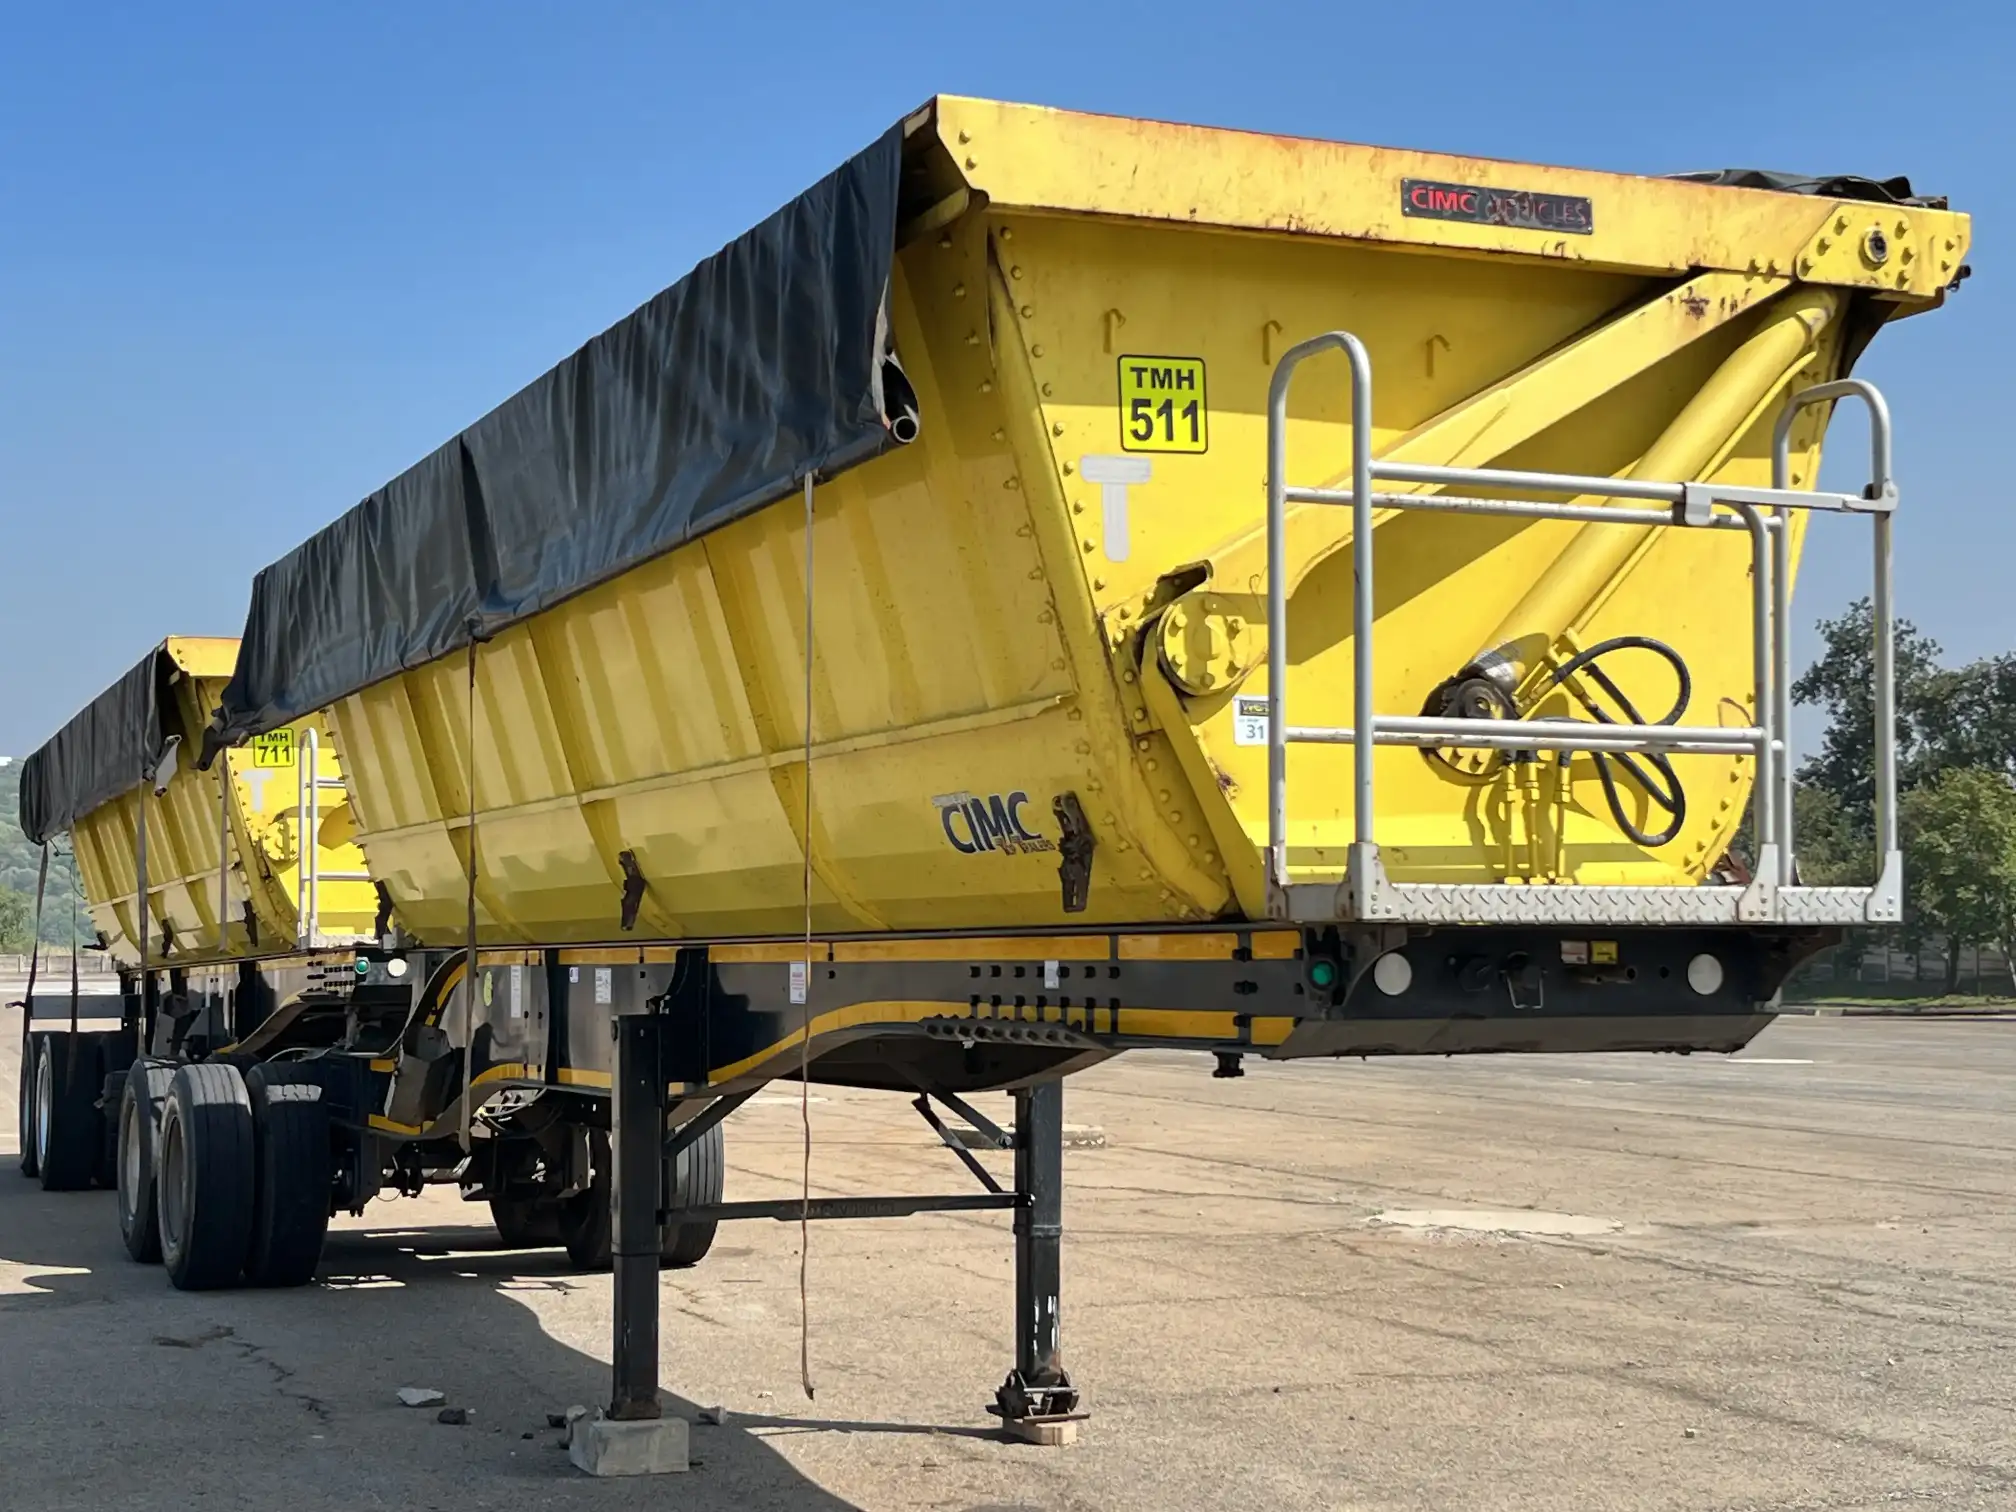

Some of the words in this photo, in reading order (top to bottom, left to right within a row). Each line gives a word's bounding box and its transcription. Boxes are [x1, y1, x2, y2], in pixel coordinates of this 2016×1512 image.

[1411, 186, 1478, 214] CIMC
[1130, 366, 1195, 390] TMH
[1130, 397, 1199, 442] 511
[1245, 724, 1264, 740] 31
[258, 744, 290, 763] 711
[942, 791, 1042, 853] CIMC
